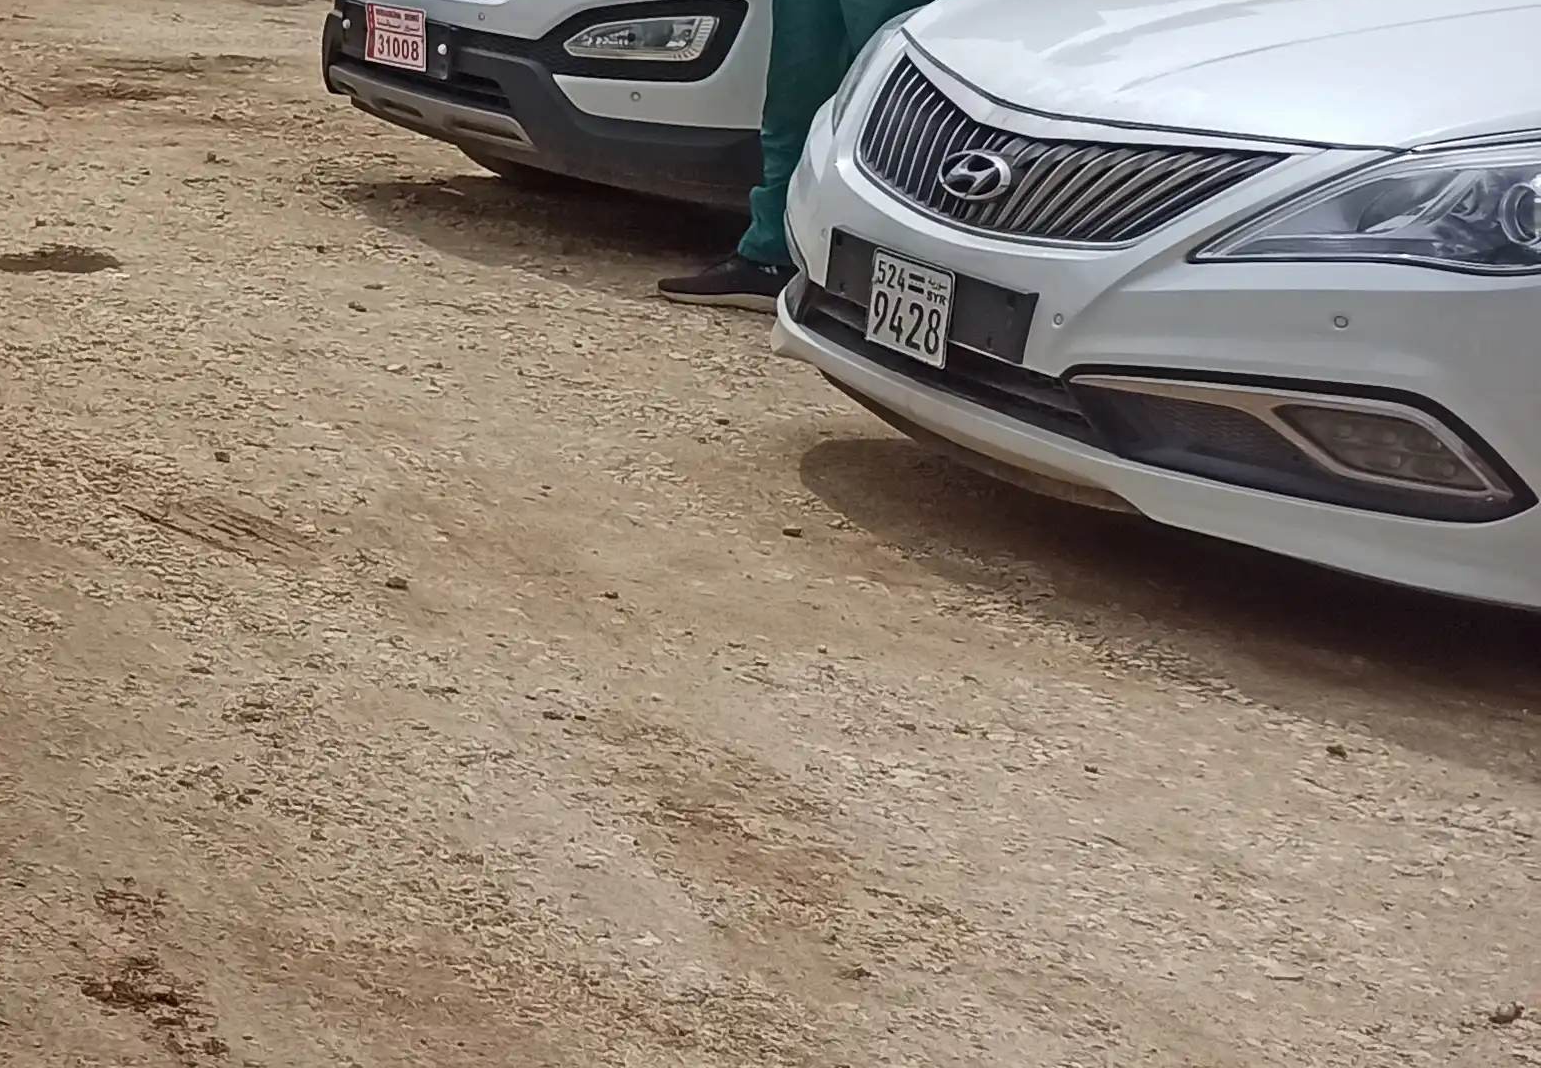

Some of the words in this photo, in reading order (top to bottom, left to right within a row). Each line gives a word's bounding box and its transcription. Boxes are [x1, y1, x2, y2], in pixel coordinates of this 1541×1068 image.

[377, 34, 419, 61] 31008
[877, 260, 905, 293] 524
[926, 291, 948, 306] SYR
[873, 290, 941, 355] 9428
